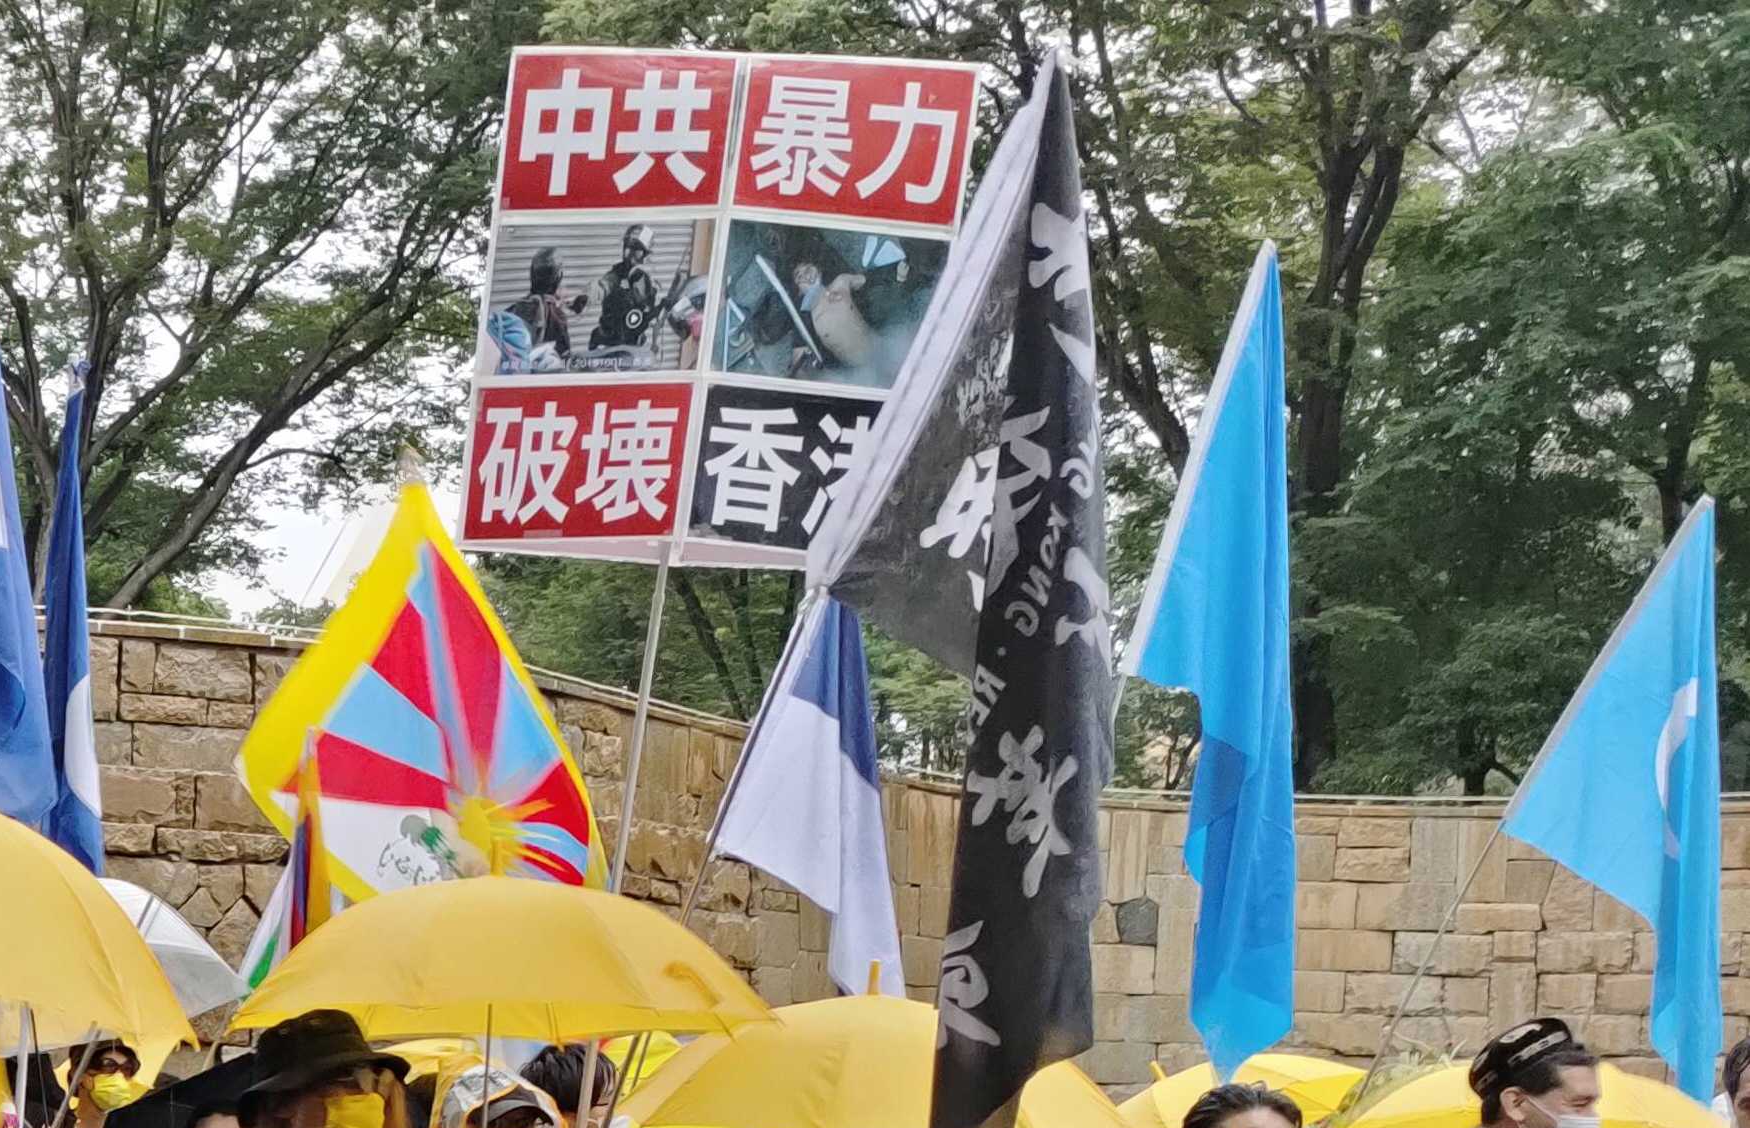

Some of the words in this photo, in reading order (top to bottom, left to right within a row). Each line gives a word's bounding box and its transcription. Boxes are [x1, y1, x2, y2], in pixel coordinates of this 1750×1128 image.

[518, 67, 713, 196] 中共
[749, 74, 960, 205] 暴力
[477, 399, 680, 526] 破壊
